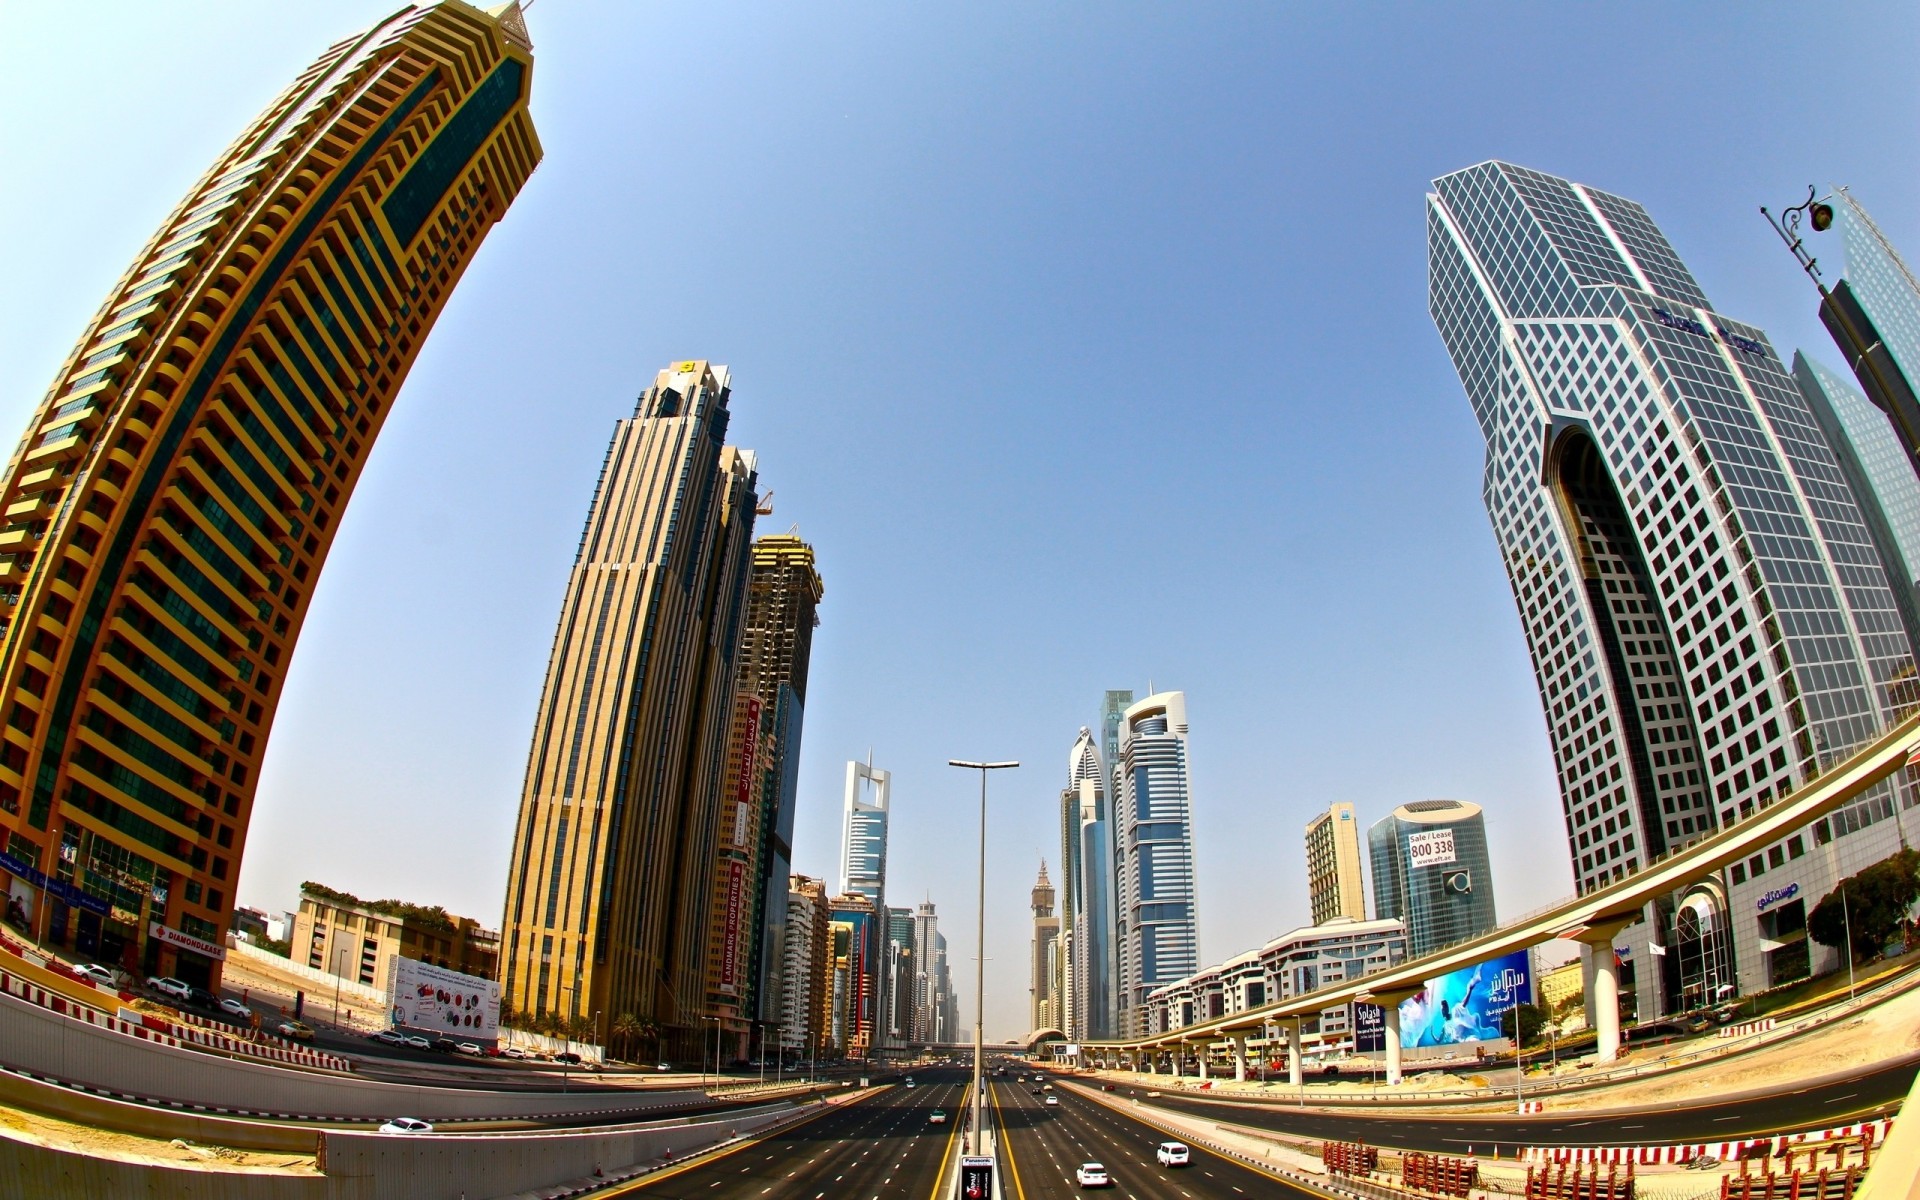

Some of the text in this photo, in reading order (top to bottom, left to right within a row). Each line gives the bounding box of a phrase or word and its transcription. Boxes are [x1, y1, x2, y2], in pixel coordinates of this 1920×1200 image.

[1410, 834, 1427, 843] Sale
[1432, 831, 1452, 839] Lease
[1411, 840, 1454, 858] 800 338
[729, 877, 739, 930] PROPERTIES
[168, 931, 222, 956] DIAMONDLEASE
[725, 933, 735, 982] LANDMARK
[1358, 1004, 1381, 1025] Splash
